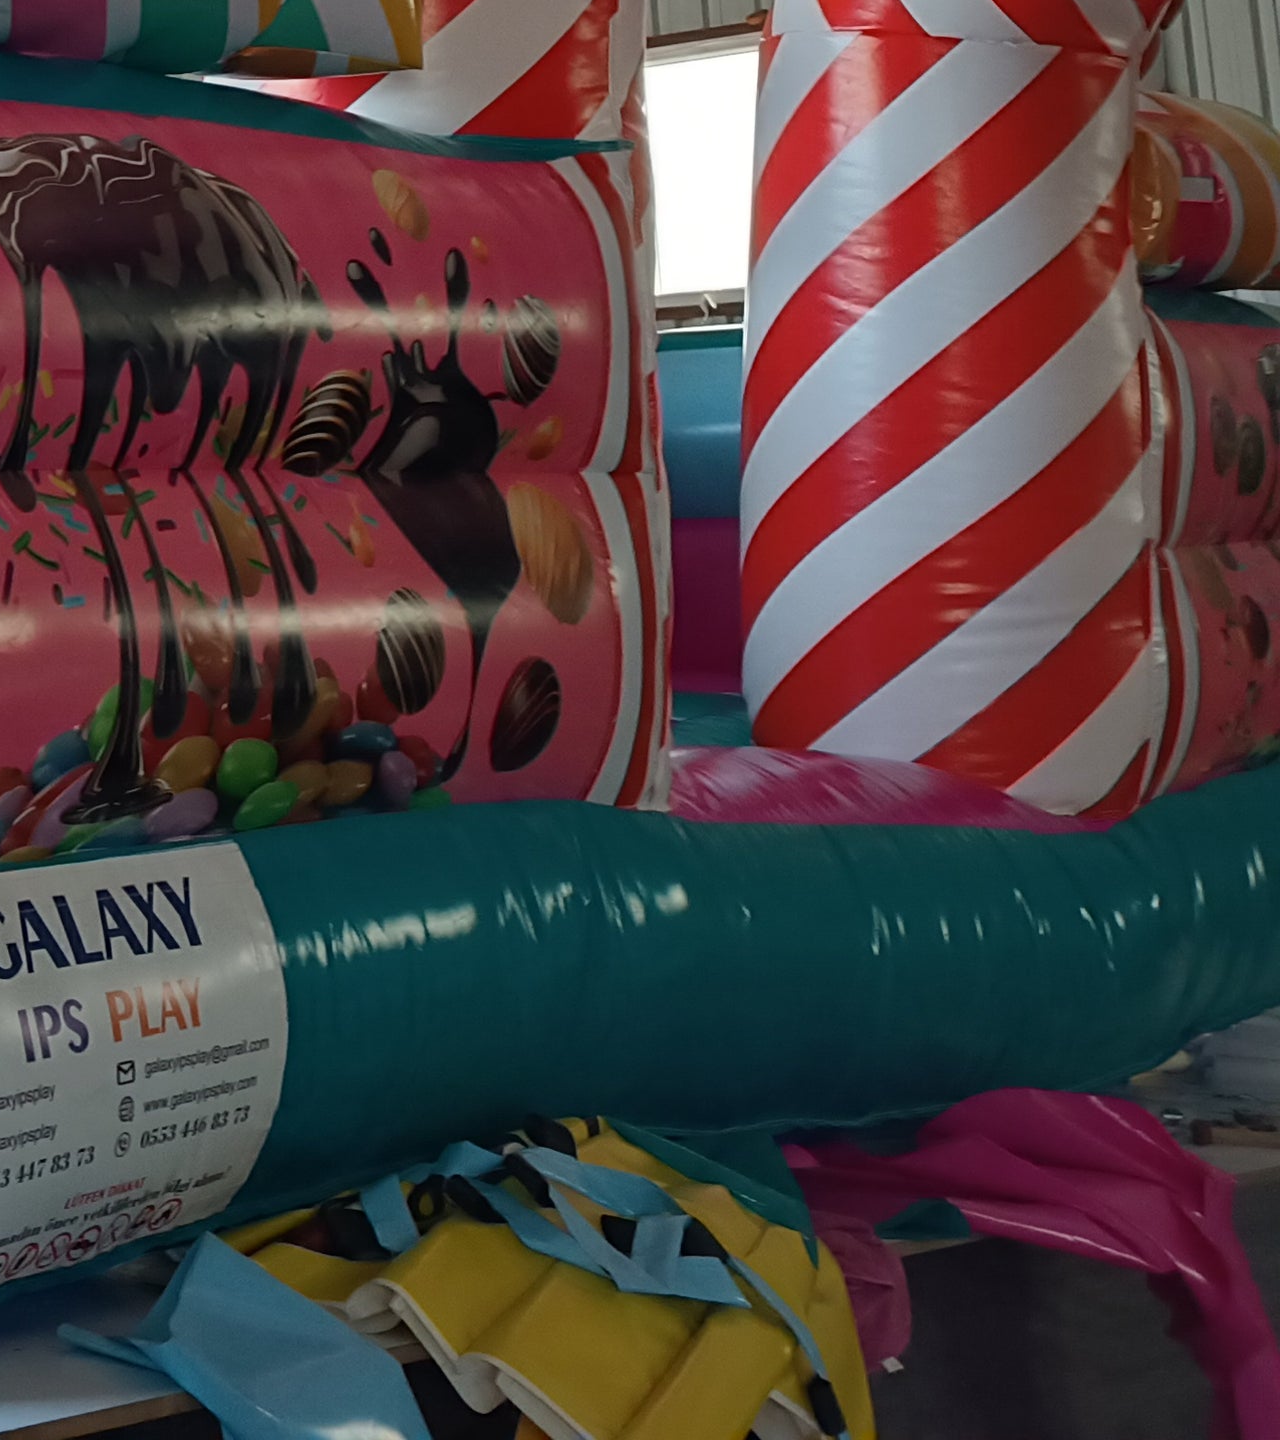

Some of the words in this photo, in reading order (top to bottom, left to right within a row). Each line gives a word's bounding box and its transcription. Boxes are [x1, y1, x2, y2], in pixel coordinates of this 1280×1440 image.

[17, 998, 90, 1063] IPS
[104, 977, 202, 1043] PLAY
[140, 1124, 177, 1149] 0553
[210, 1110, 229, 1130] 83
[233, 1105, 250, 1125] 73
[15, 1158, 47, 1184] 447
[50, 1152, 71, 1174] 83
[77, 1146, 95, 1168] 73
